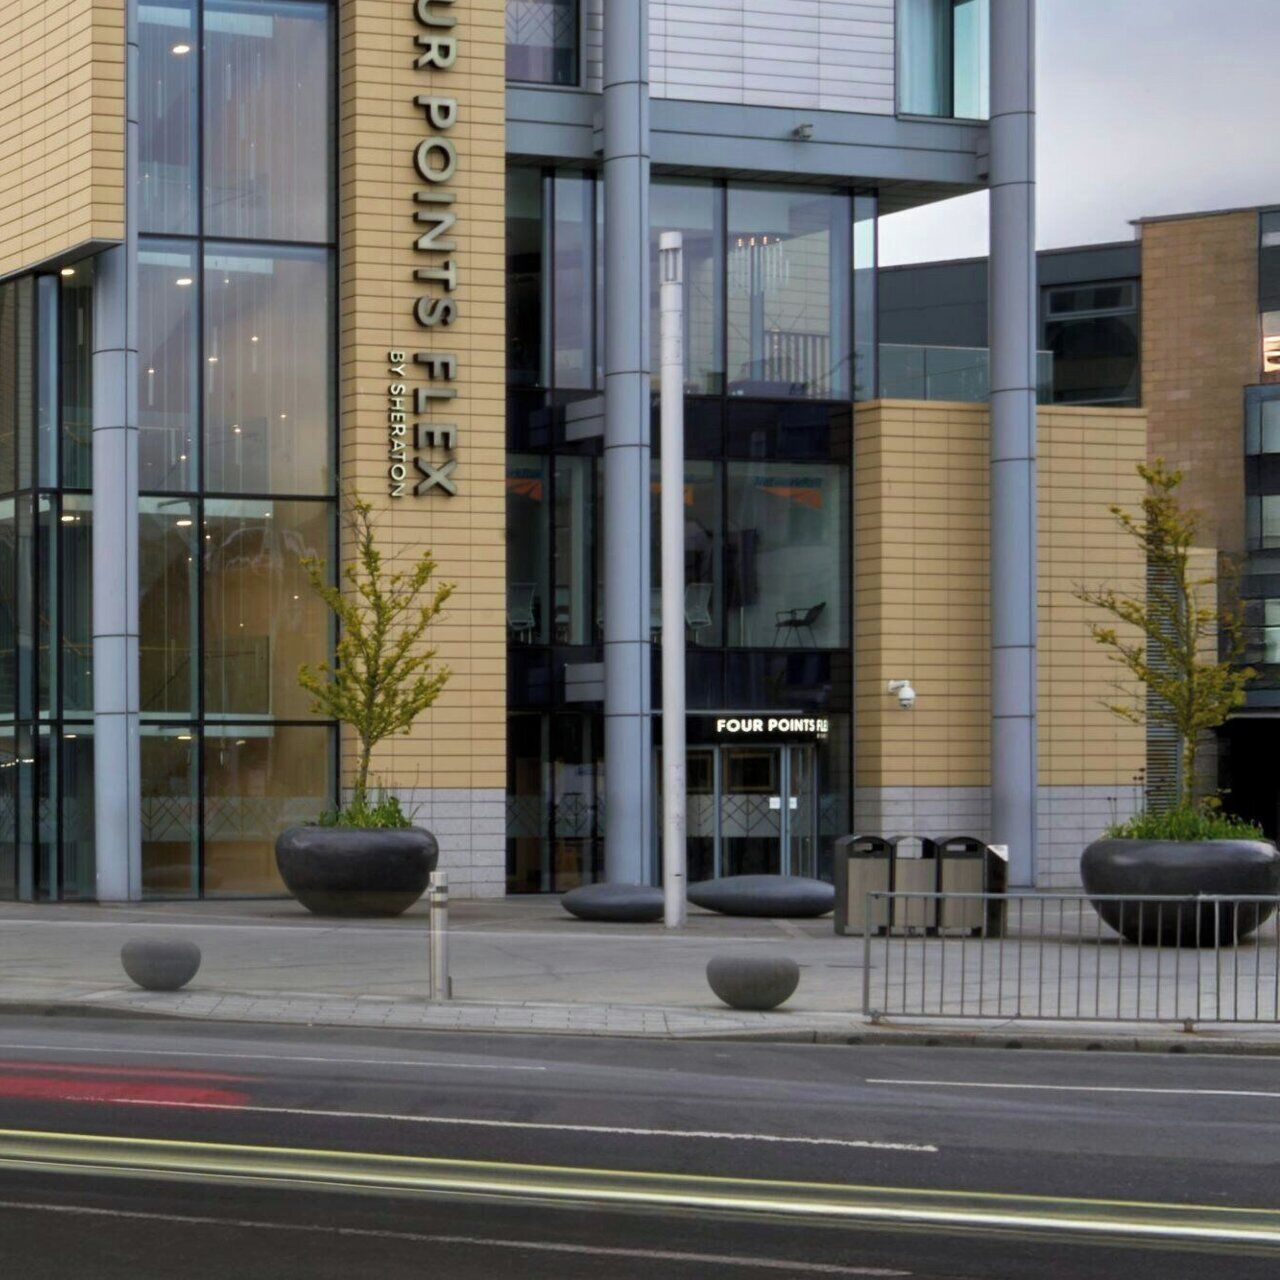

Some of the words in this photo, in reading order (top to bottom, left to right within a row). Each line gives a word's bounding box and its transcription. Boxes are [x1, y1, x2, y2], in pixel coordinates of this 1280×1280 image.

[413, 95, 458, 327] POINTS
[389, 351, 406, 377] BY
[389, 383, 407, 498] SHERATON
[413, 353, 458, 497] FLEX
[716, 719, 764, 732] FOUR
[767, 719, 815, 732] POINTS
